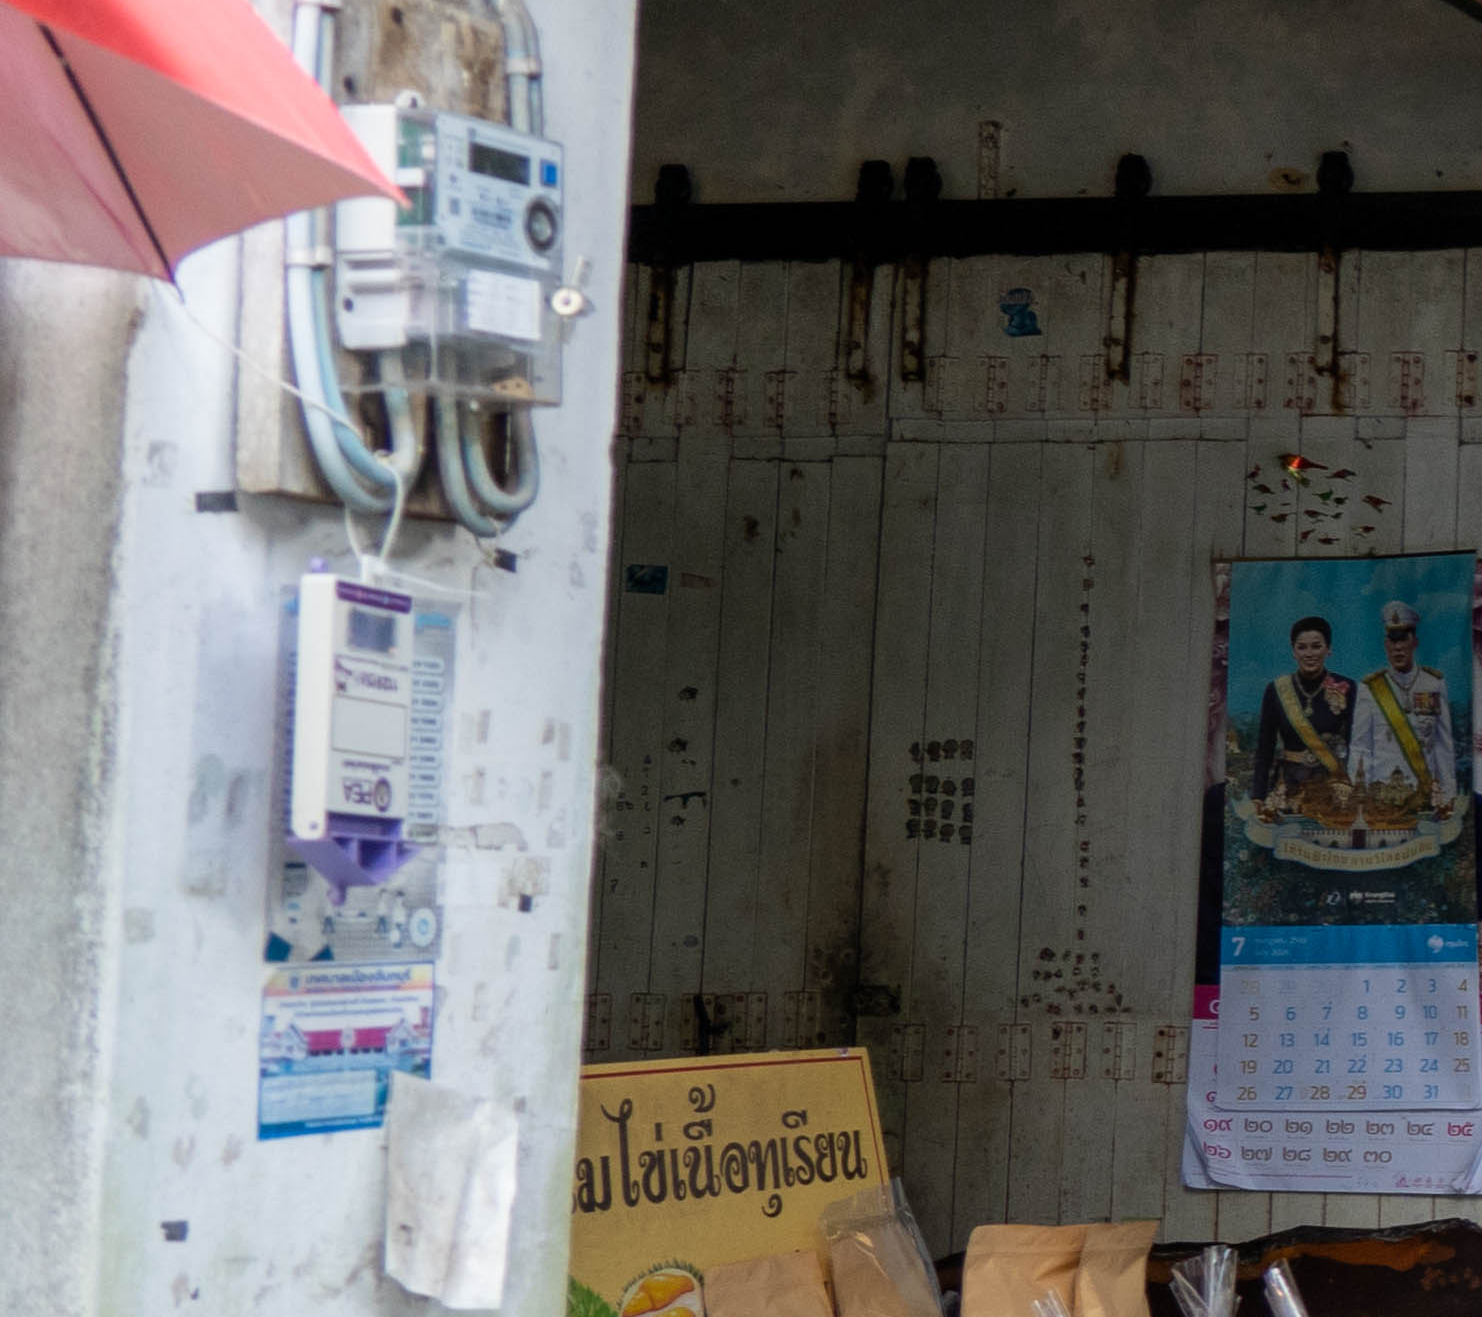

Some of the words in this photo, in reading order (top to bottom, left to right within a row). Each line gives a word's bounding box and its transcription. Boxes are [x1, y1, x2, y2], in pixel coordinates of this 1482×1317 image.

[1231, 936, 1246, 957] 7
[1250, 1008, 1260, 1020] 5
[1286, 1008, 1296, 1020] 6
[1322, 1007, 1331, 1019] 7
[1357, 1007, 1368, 1019] 8
[1395, 1006, 1405, 1018] 9
[1423, 1006, 1437, 1018] 10
[1457, 1006, 1468, 1018] 11
[1243, 1035, 1257, 1048] 12
[1280, 1034, 1295, 1047] 13
[1314, 1033, 1330, 1046] 14
[1352, 1033, 1368, 1046] 15
[1388, 1033, 1404, 1045] 16
[1425, 1032, 1438, 1044] 17
[1454, 1032, 1469, 1045] 18
[1240, 1061, 1257, 1074] 19
[1272, 1060, 1293, 1074] 20
[1315, 1060, 1330, 1073] 21
[1347, 1060, 1366, 1073] 22
[1384, 1059, 1403, 1073] 23
[1420, 1059, 1438, 1072] 24
[1453, 1059, 1470, 1072] 25
[1237, 1087, 1257, 1101] 26
[1275, 1086, 1293, 1100] 27
[1311, 1086, 1330, 1099] 28
[1347, 1086, 1367, 1099] 29
[1383, 1086, 1403, 1099] 30
[1423, 1085, 1438, 1098] 31
[571, 1083, 868, 1218] มไข่เนื้อทุเรียน
